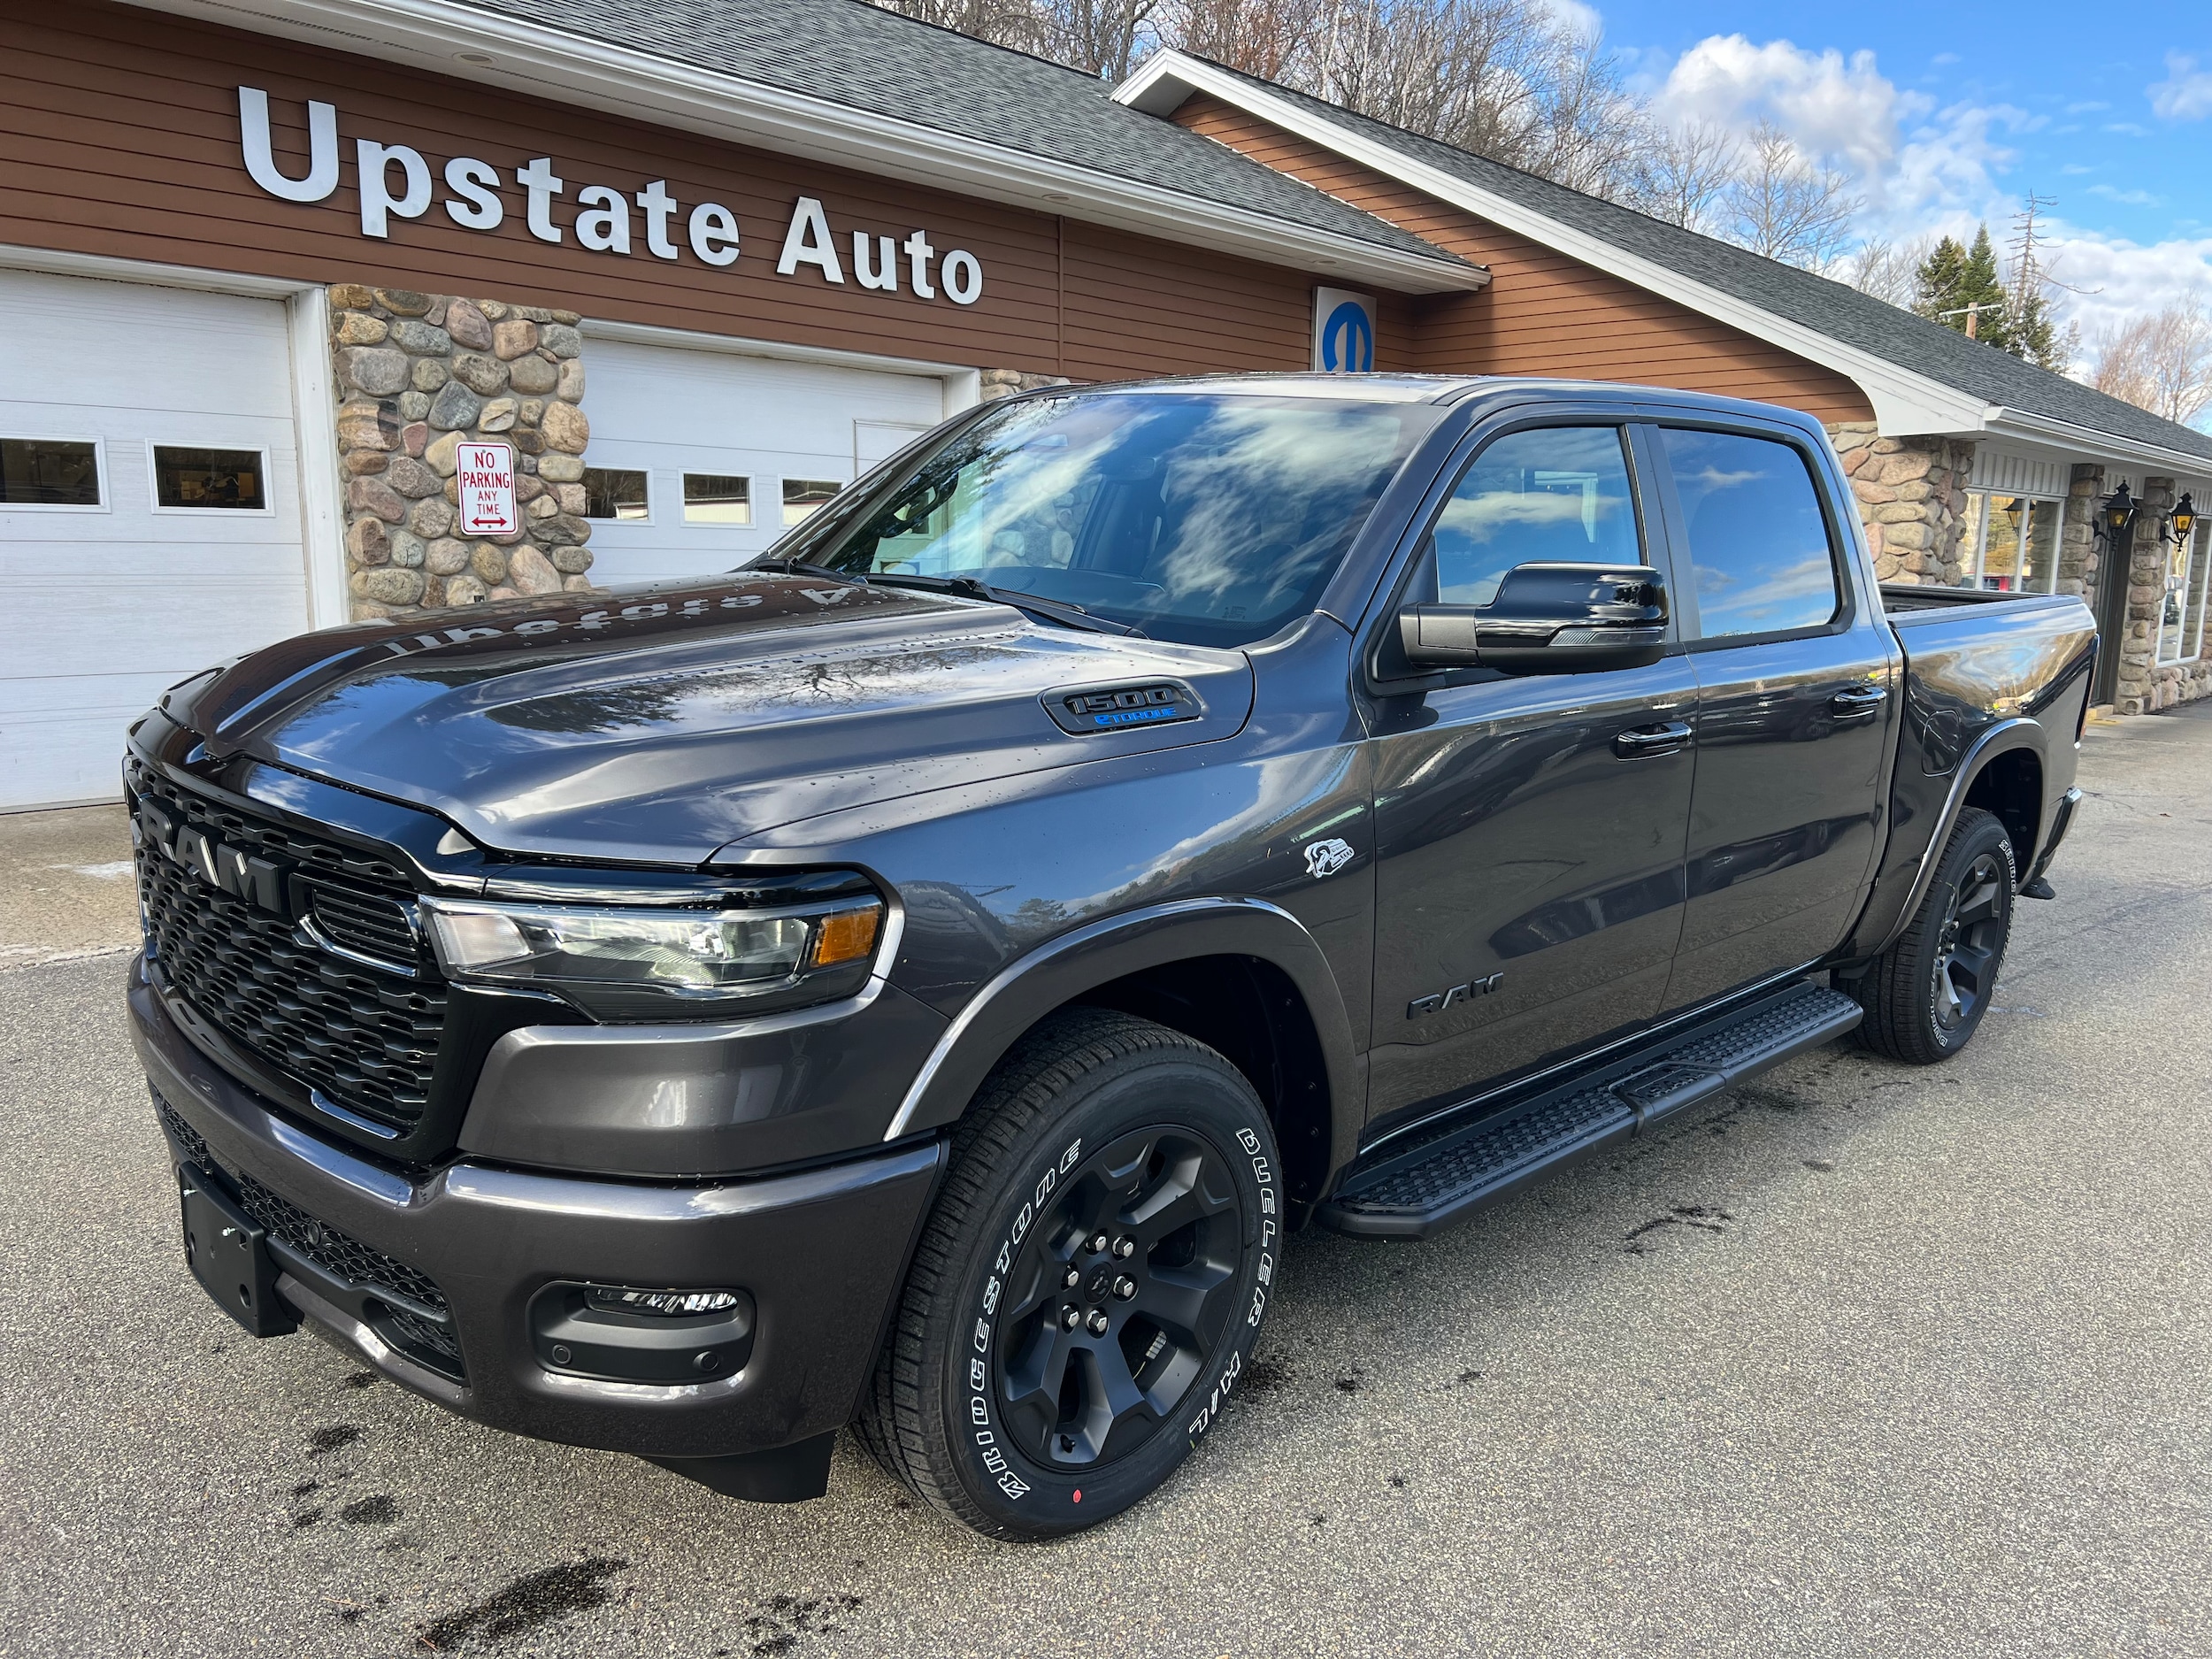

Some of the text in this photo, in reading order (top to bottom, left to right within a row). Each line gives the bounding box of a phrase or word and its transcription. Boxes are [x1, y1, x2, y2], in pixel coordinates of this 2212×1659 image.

[238, 85, 984, 306] Upstate Auto
[474, 451, 495, 469] NO
[463, 472, 510, 488] PARKING
[478, 490, 497, 502] ANY
[477, 503, 501, 515] TIME
[1067, 687, 1174, 715] 1500
[139, 795, 283, 913] RAM
[1405, 971, 1504, 1020] RAM
[1235, 1127, 1276, 1327] DUELER
[970, 1138, 1082, 1501] BRIDGESTONE
